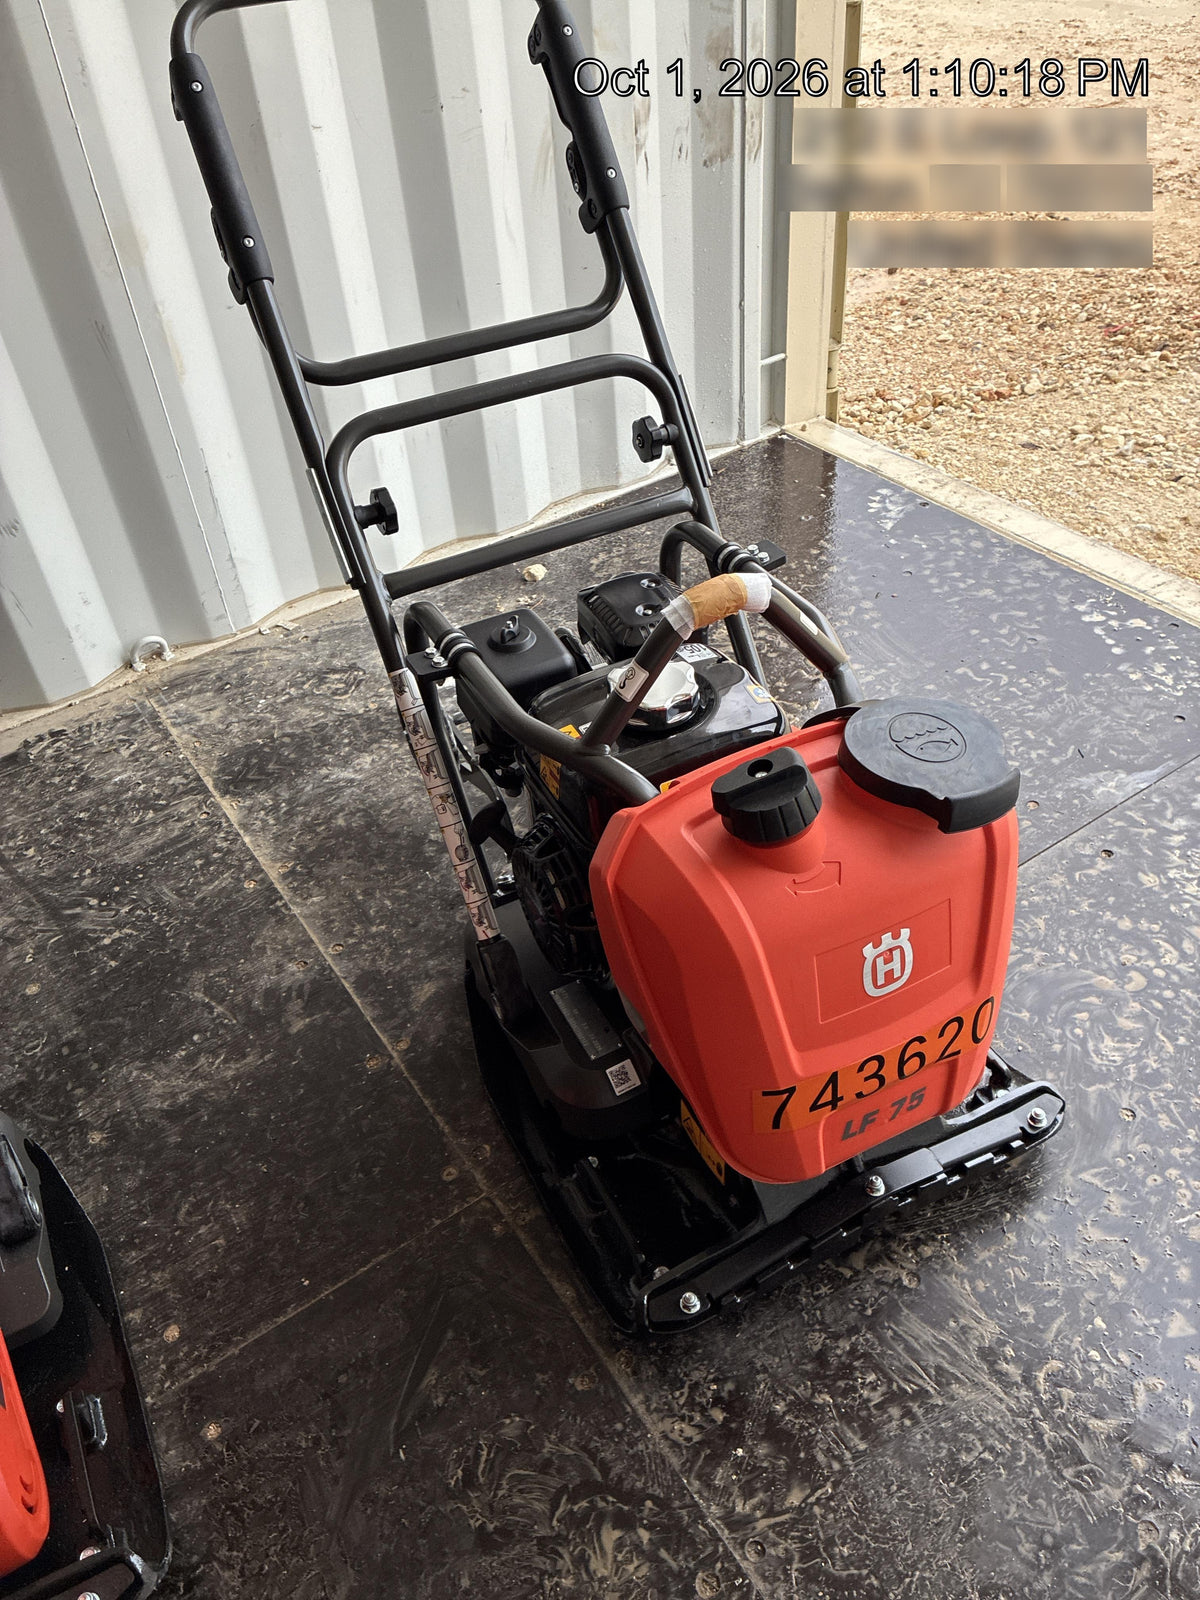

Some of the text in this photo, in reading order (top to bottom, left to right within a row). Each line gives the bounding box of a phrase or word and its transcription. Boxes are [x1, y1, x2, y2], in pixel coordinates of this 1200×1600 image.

[761, 996, 995, 1130] 743620
[840, 1086, 927, 1141] LF 75
